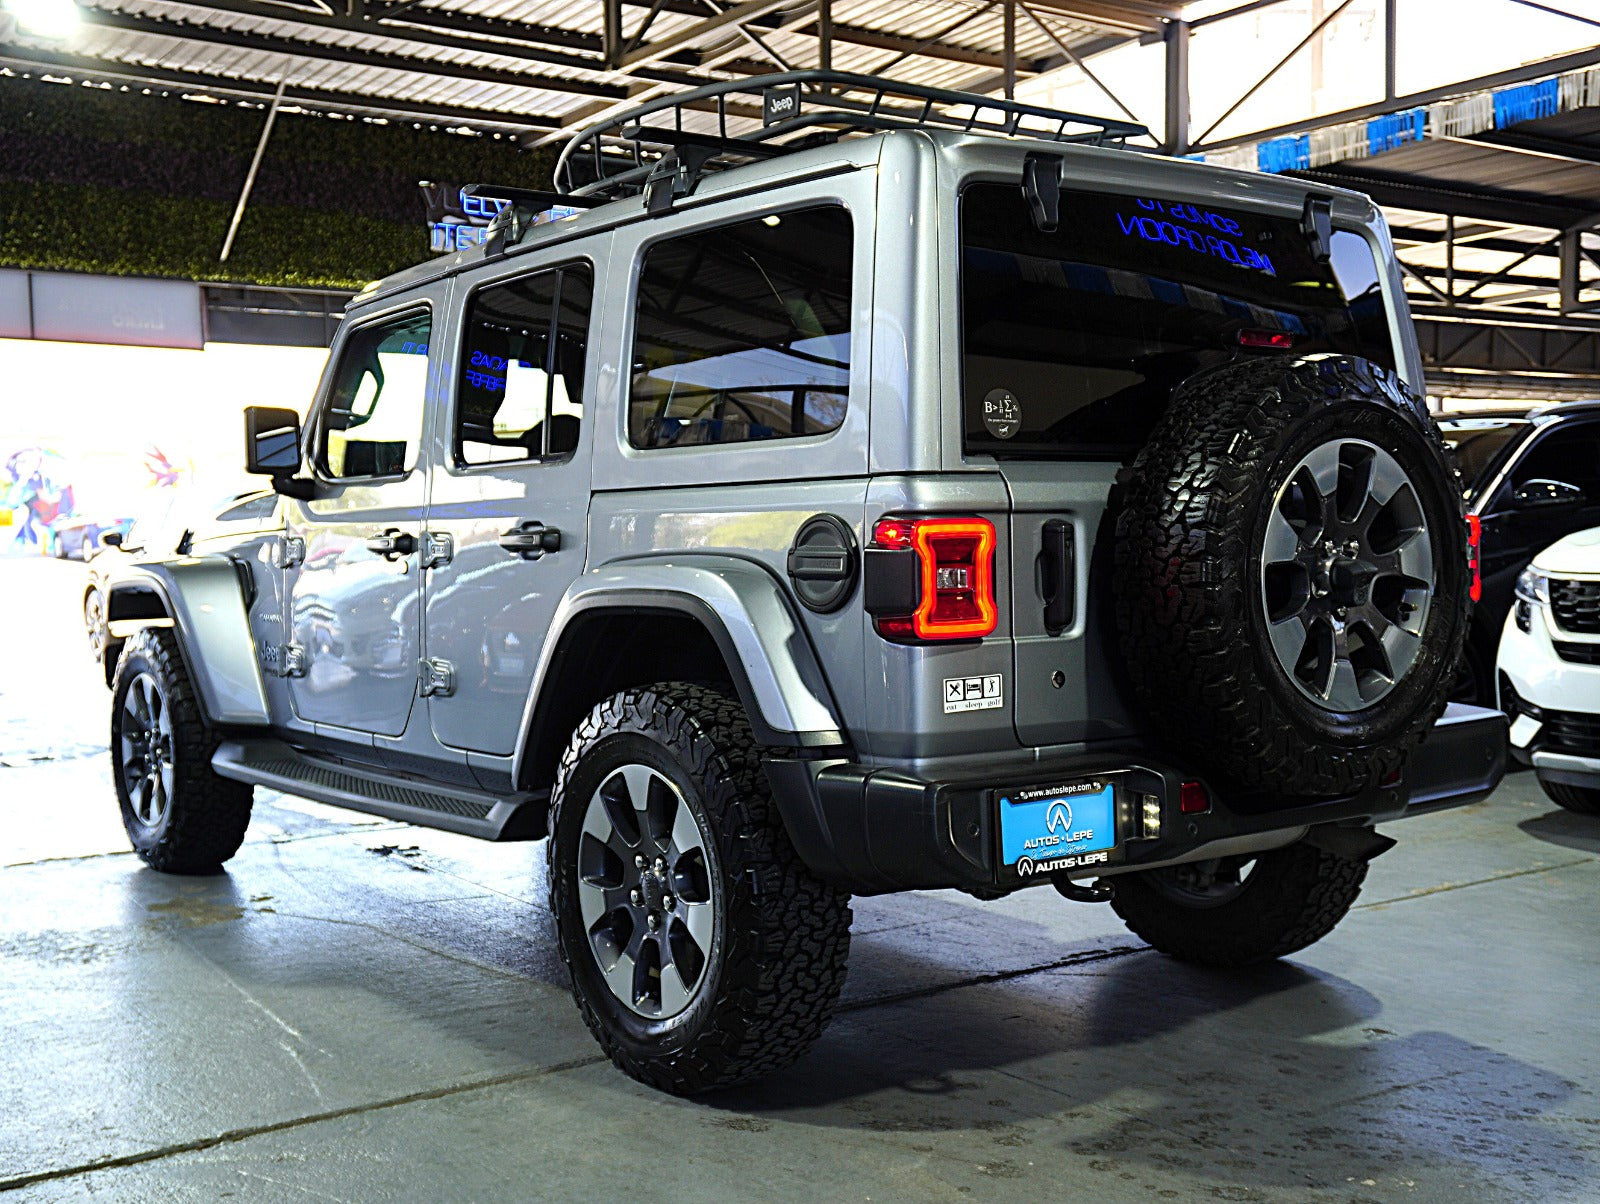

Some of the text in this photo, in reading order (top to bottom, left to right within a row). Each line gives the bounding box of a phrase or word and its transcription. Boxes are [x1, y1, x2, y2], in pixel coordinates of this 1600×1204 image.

[770, 96, 793, 113] Jeep
[964, 701, 983, 709] sleep
[987, 698, 1001, 707] golf
[1027, 783, 1092, 798] www.autoslepe.com
